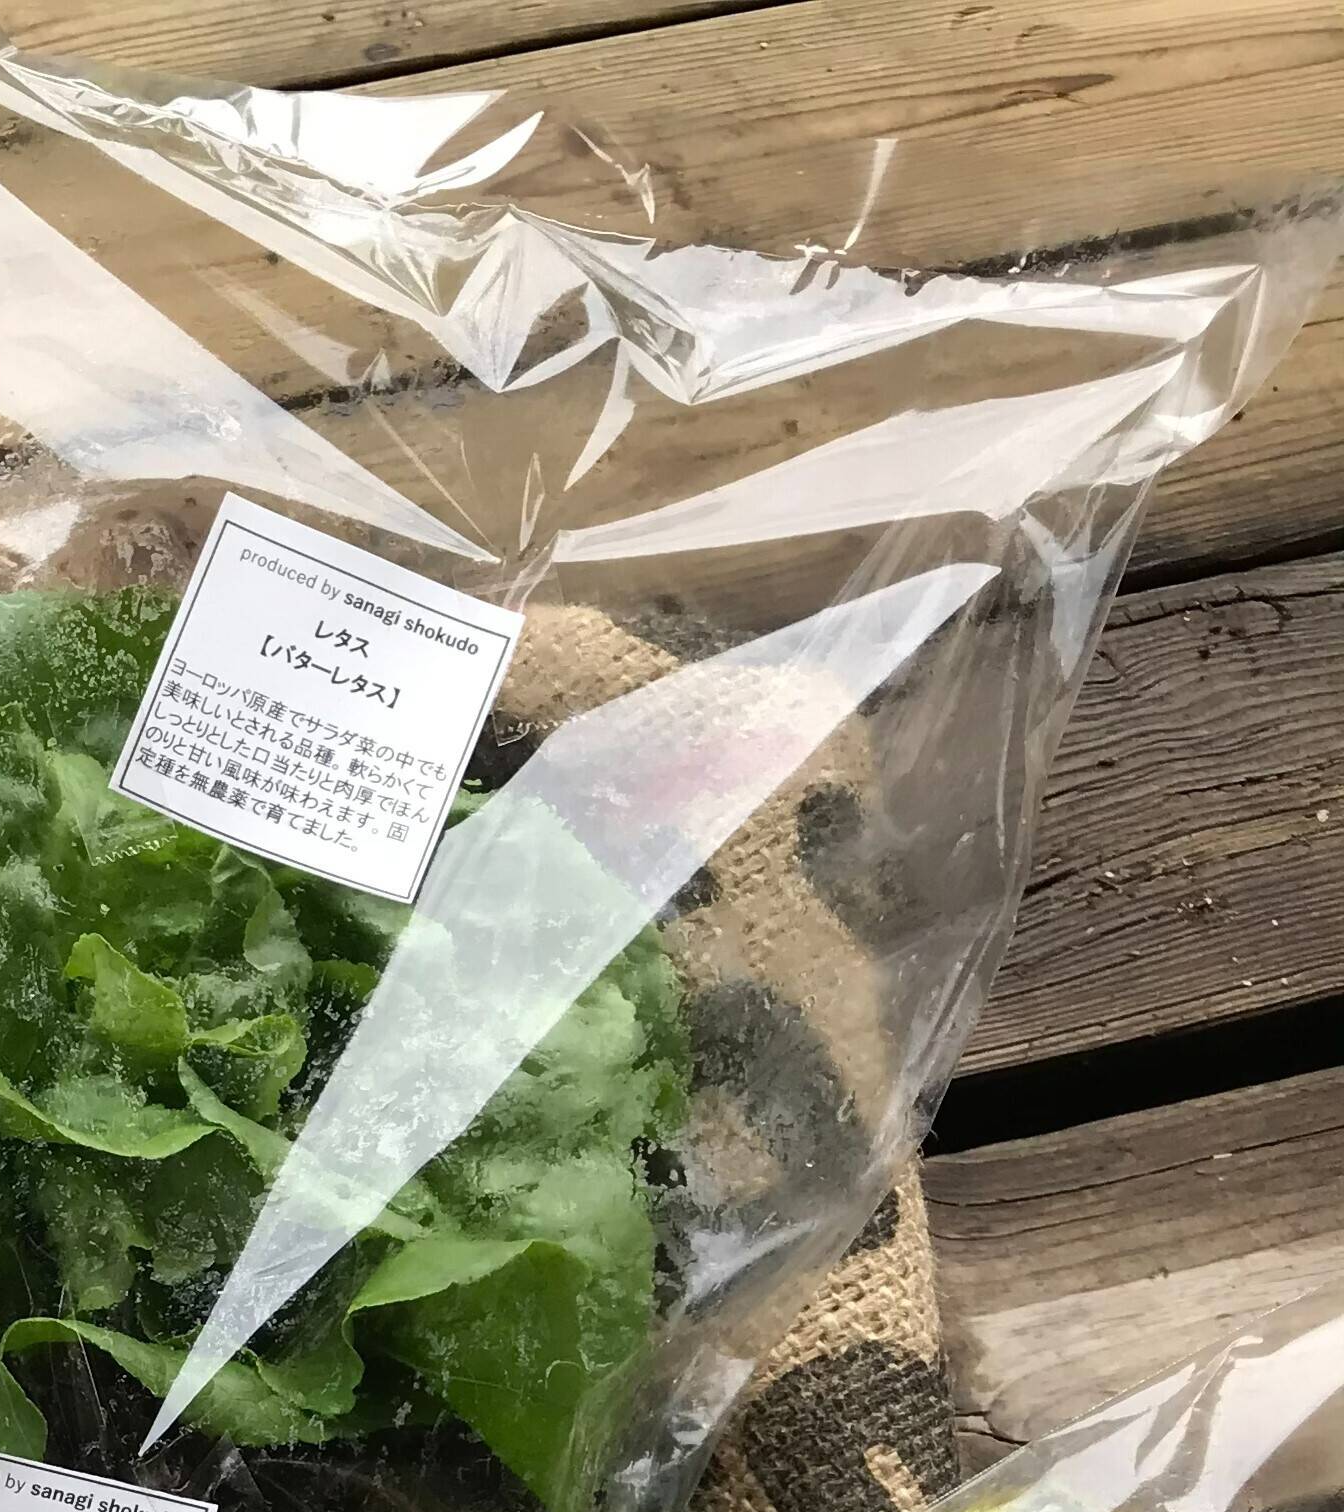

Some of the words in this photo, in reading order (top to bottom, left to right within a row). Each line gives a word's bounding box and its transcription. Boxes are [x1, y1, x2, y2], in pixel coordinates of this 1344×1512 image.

[239, 547, 319, 589] produced
[319, 578, 341, 600] by
[342, 592, 402, 626] sanagi
[402, 617, 479, 655] shokudo
[314, 619, 370, 659] レタス
[259, 633, 401, 709] 【バターレタス】
[3, 1472, 27, 1494] by
[27, 1483, 94, 1511] sanagi
